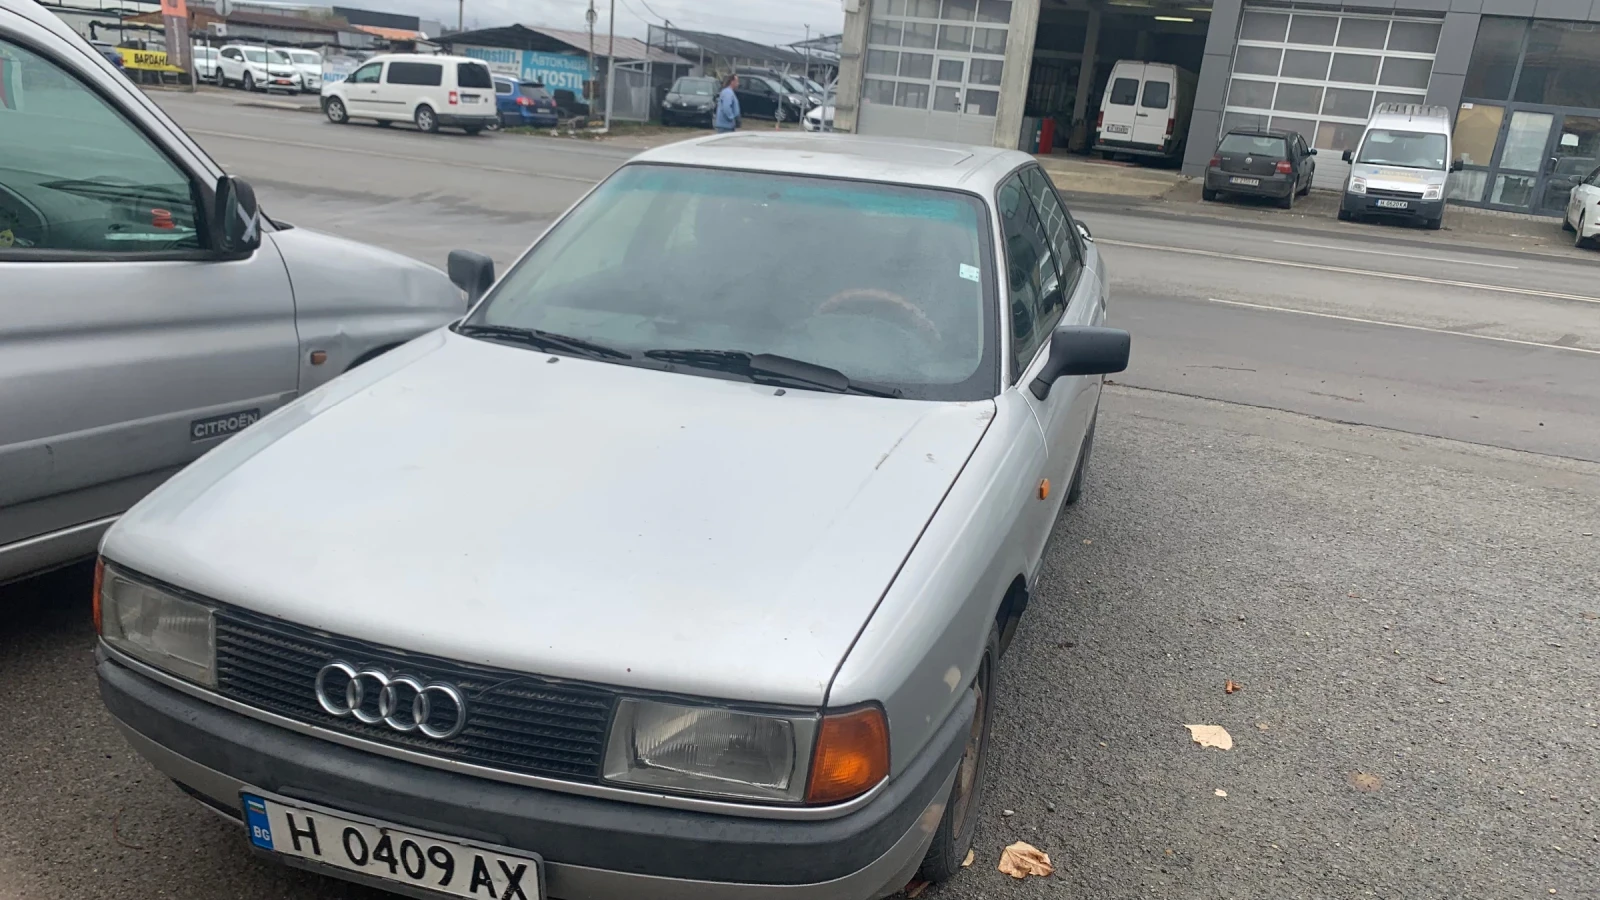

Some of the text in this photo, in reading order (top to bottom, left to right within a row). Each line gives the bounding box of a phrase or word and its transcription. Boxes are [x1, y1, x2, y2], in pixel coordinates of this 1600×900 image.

[193, 413, 258, 437] CITROËN
[253, 825, 271, 841] BG
[285, 811, 528, 900] H 0409 AX
